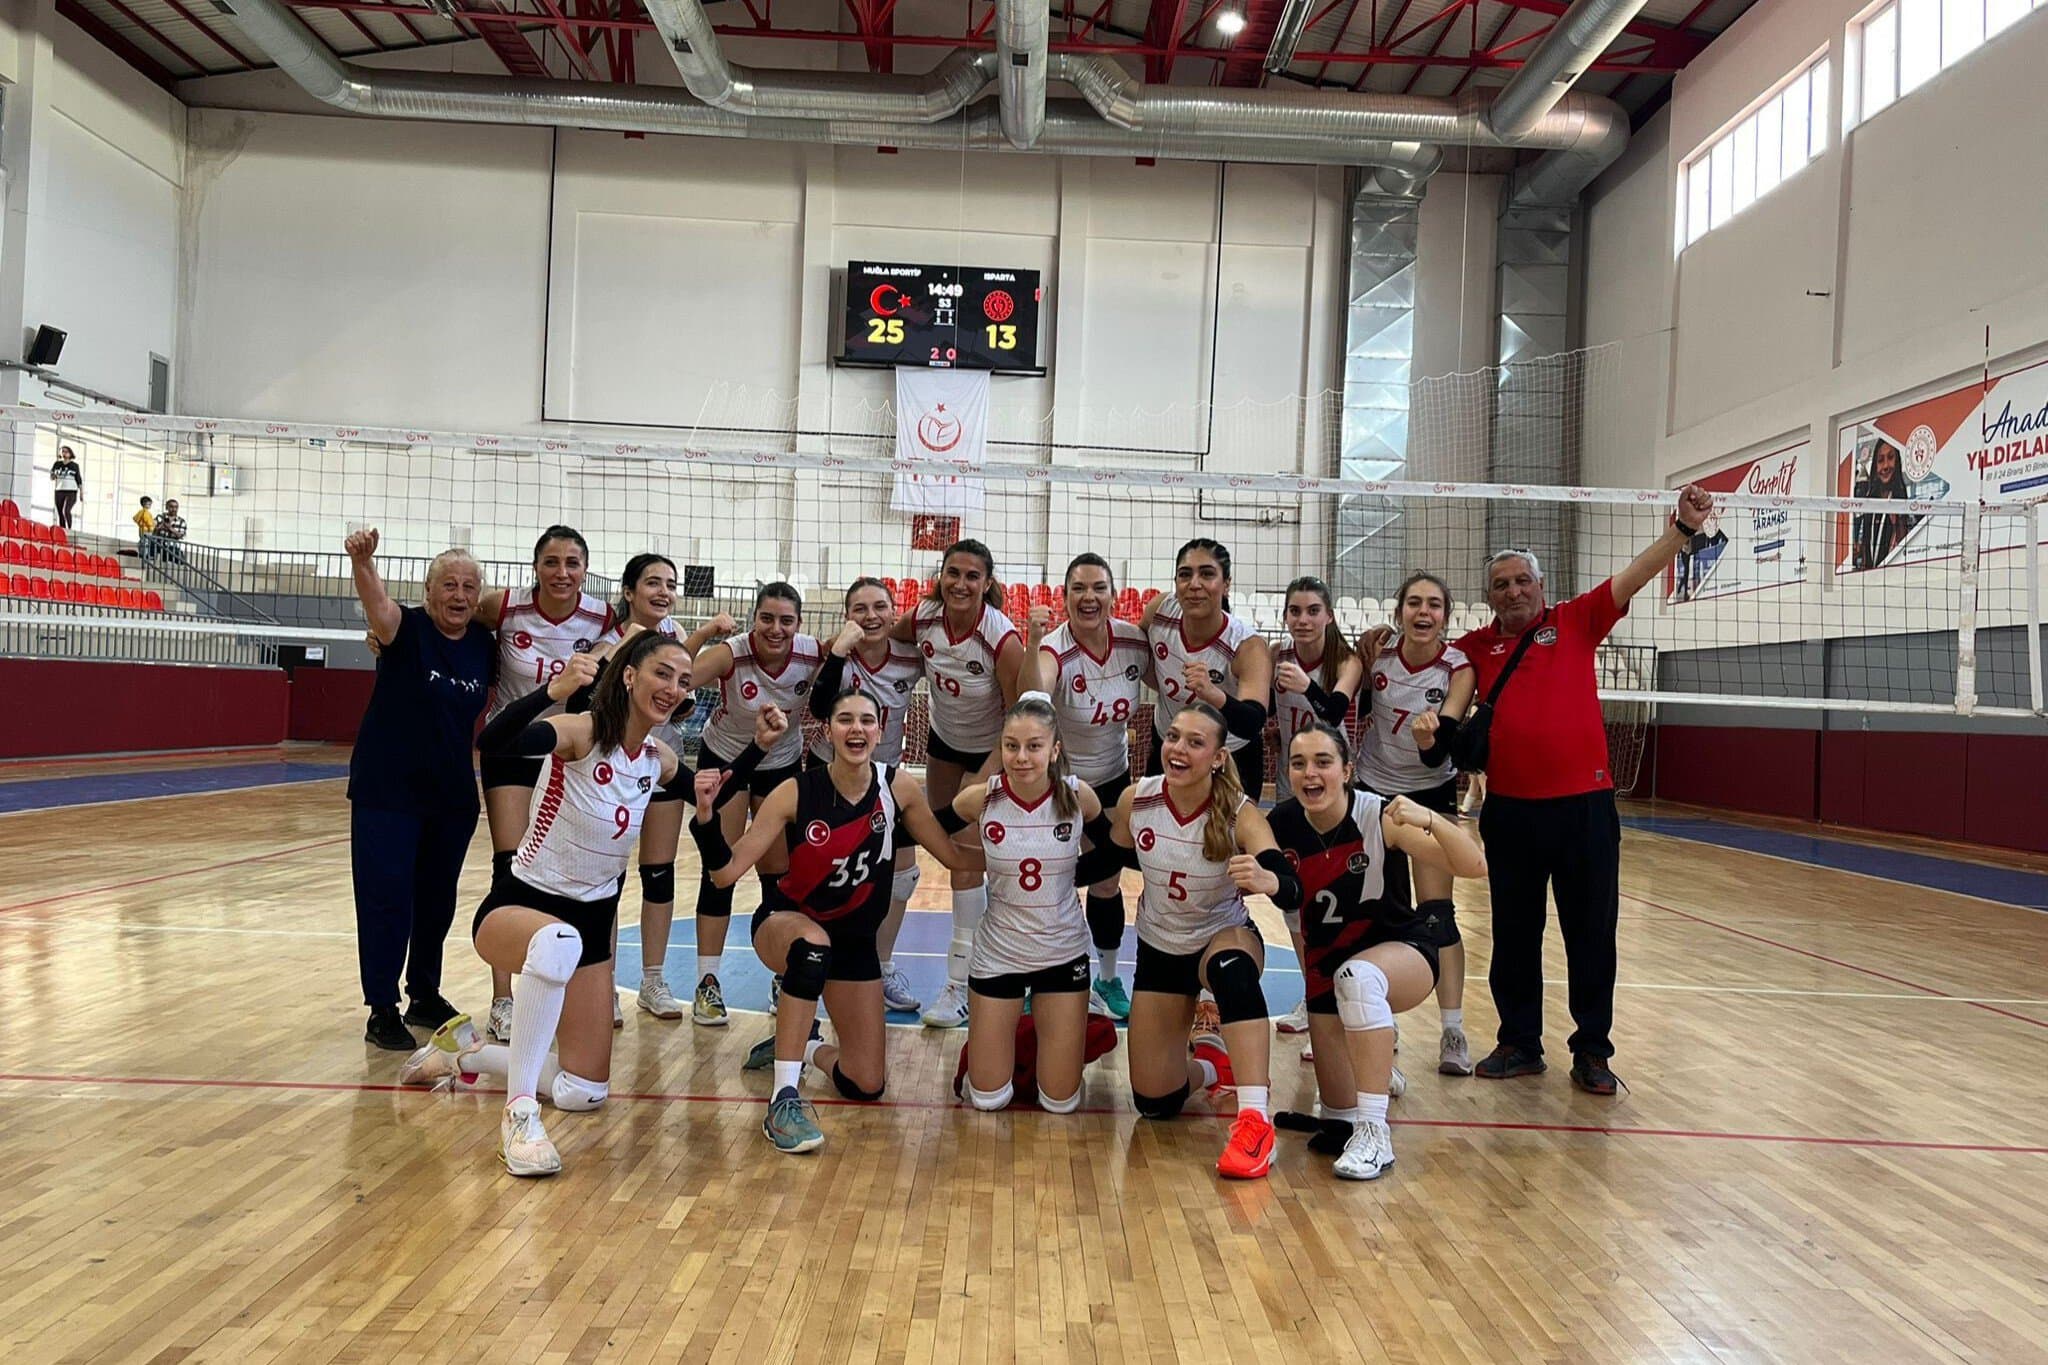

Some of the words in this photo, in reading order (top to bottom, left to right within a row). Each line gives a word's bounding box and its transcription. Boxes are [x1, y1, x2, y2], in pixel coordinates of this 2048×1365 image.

[928, 283, 964, 297] 14:49
[983, 272, 1016, 282] ISPARTA
[867, 318, 905, 344] 25
[985, 324, 1017, 350] 13
[930, 347, 939, 360] 2
[946, 348, 957, 360] 0
[1753, 511, 1788, 531] TARAMASI
[933, 671, 960, 698] 19
[1090, 698, 1130, 727] 48
[1391, 707, 1411, 735] 7
[611, 804, 631, 841] 9
[828, 849, 871, 888] 35
[1018, 857, 1042, 892] 8
[1168, 871, 1188, 902] 5
[1315, 889, 1343, 924] 2
